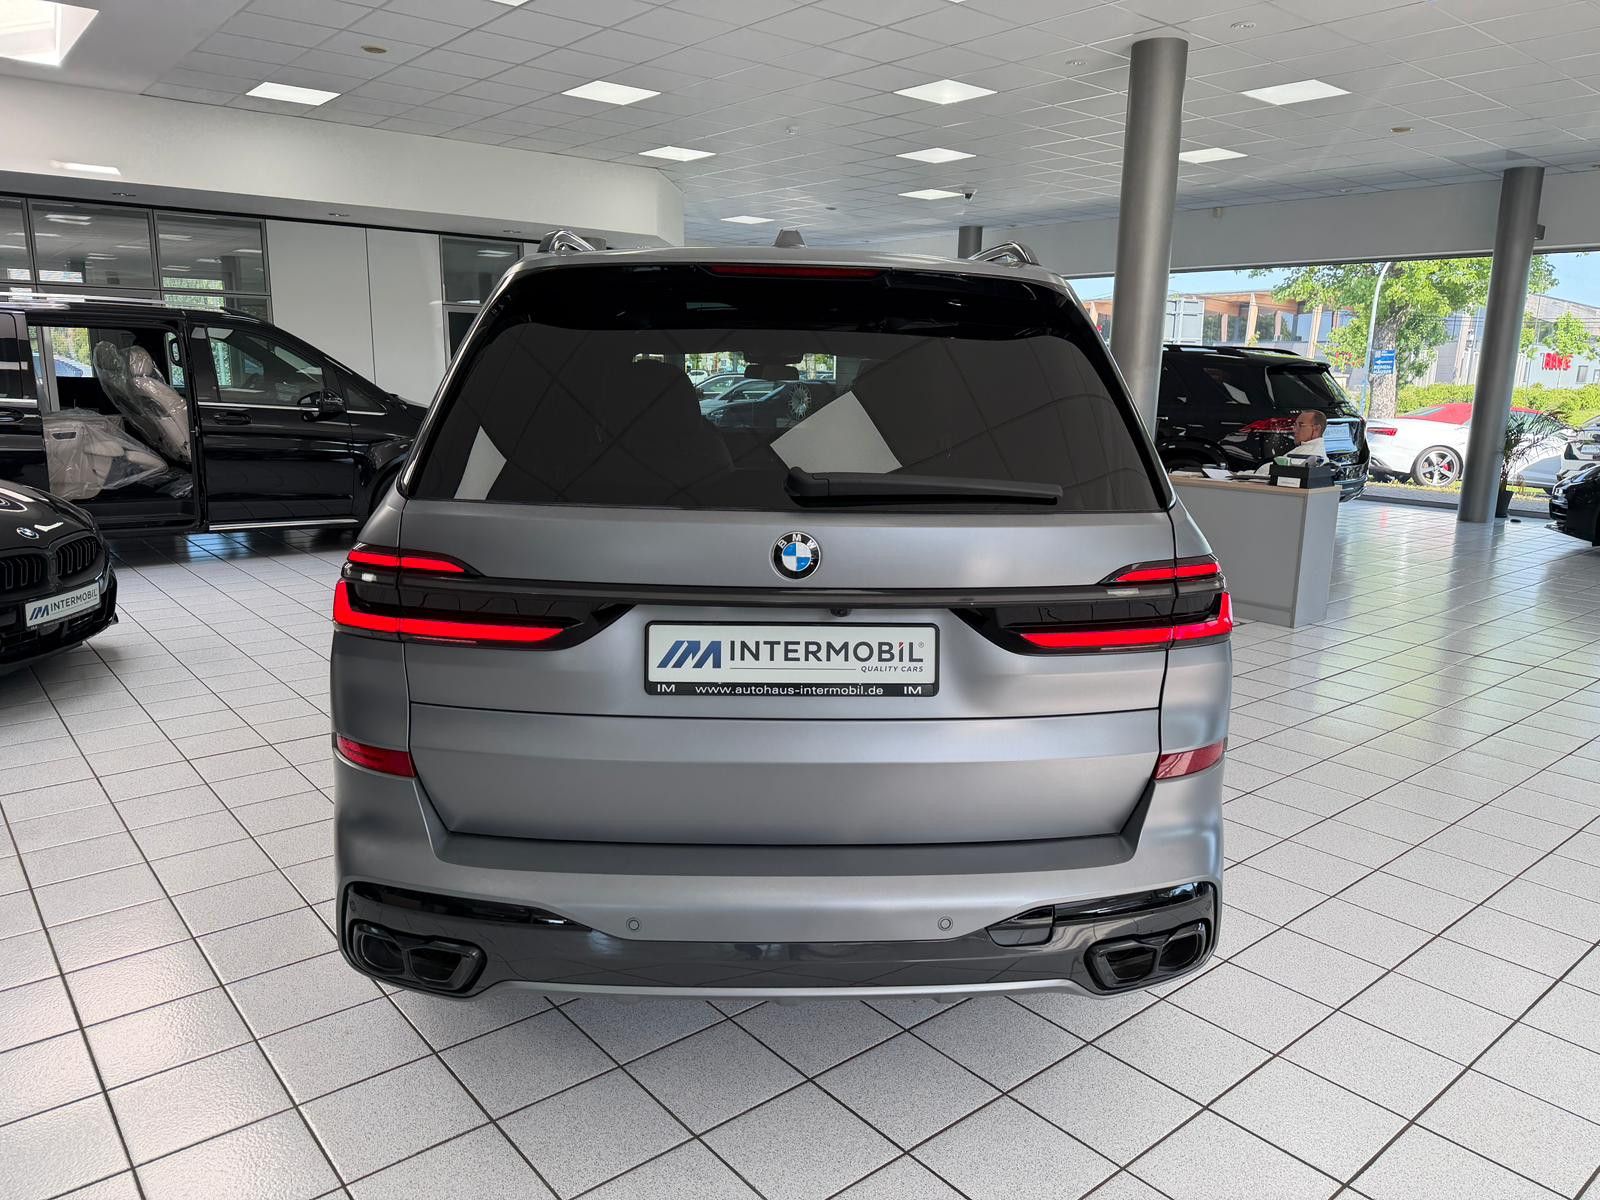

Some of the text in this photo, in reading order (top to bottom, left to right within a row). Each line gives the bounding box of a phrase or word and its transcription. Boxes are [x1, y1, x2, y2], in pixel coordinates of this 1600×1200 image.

[778, 533, 817, 549] BMW
[860, 665, 924, 673] QUALITY CARS
[657, 683, 922, 696] IM www.autohaus-intermobil.de IM
